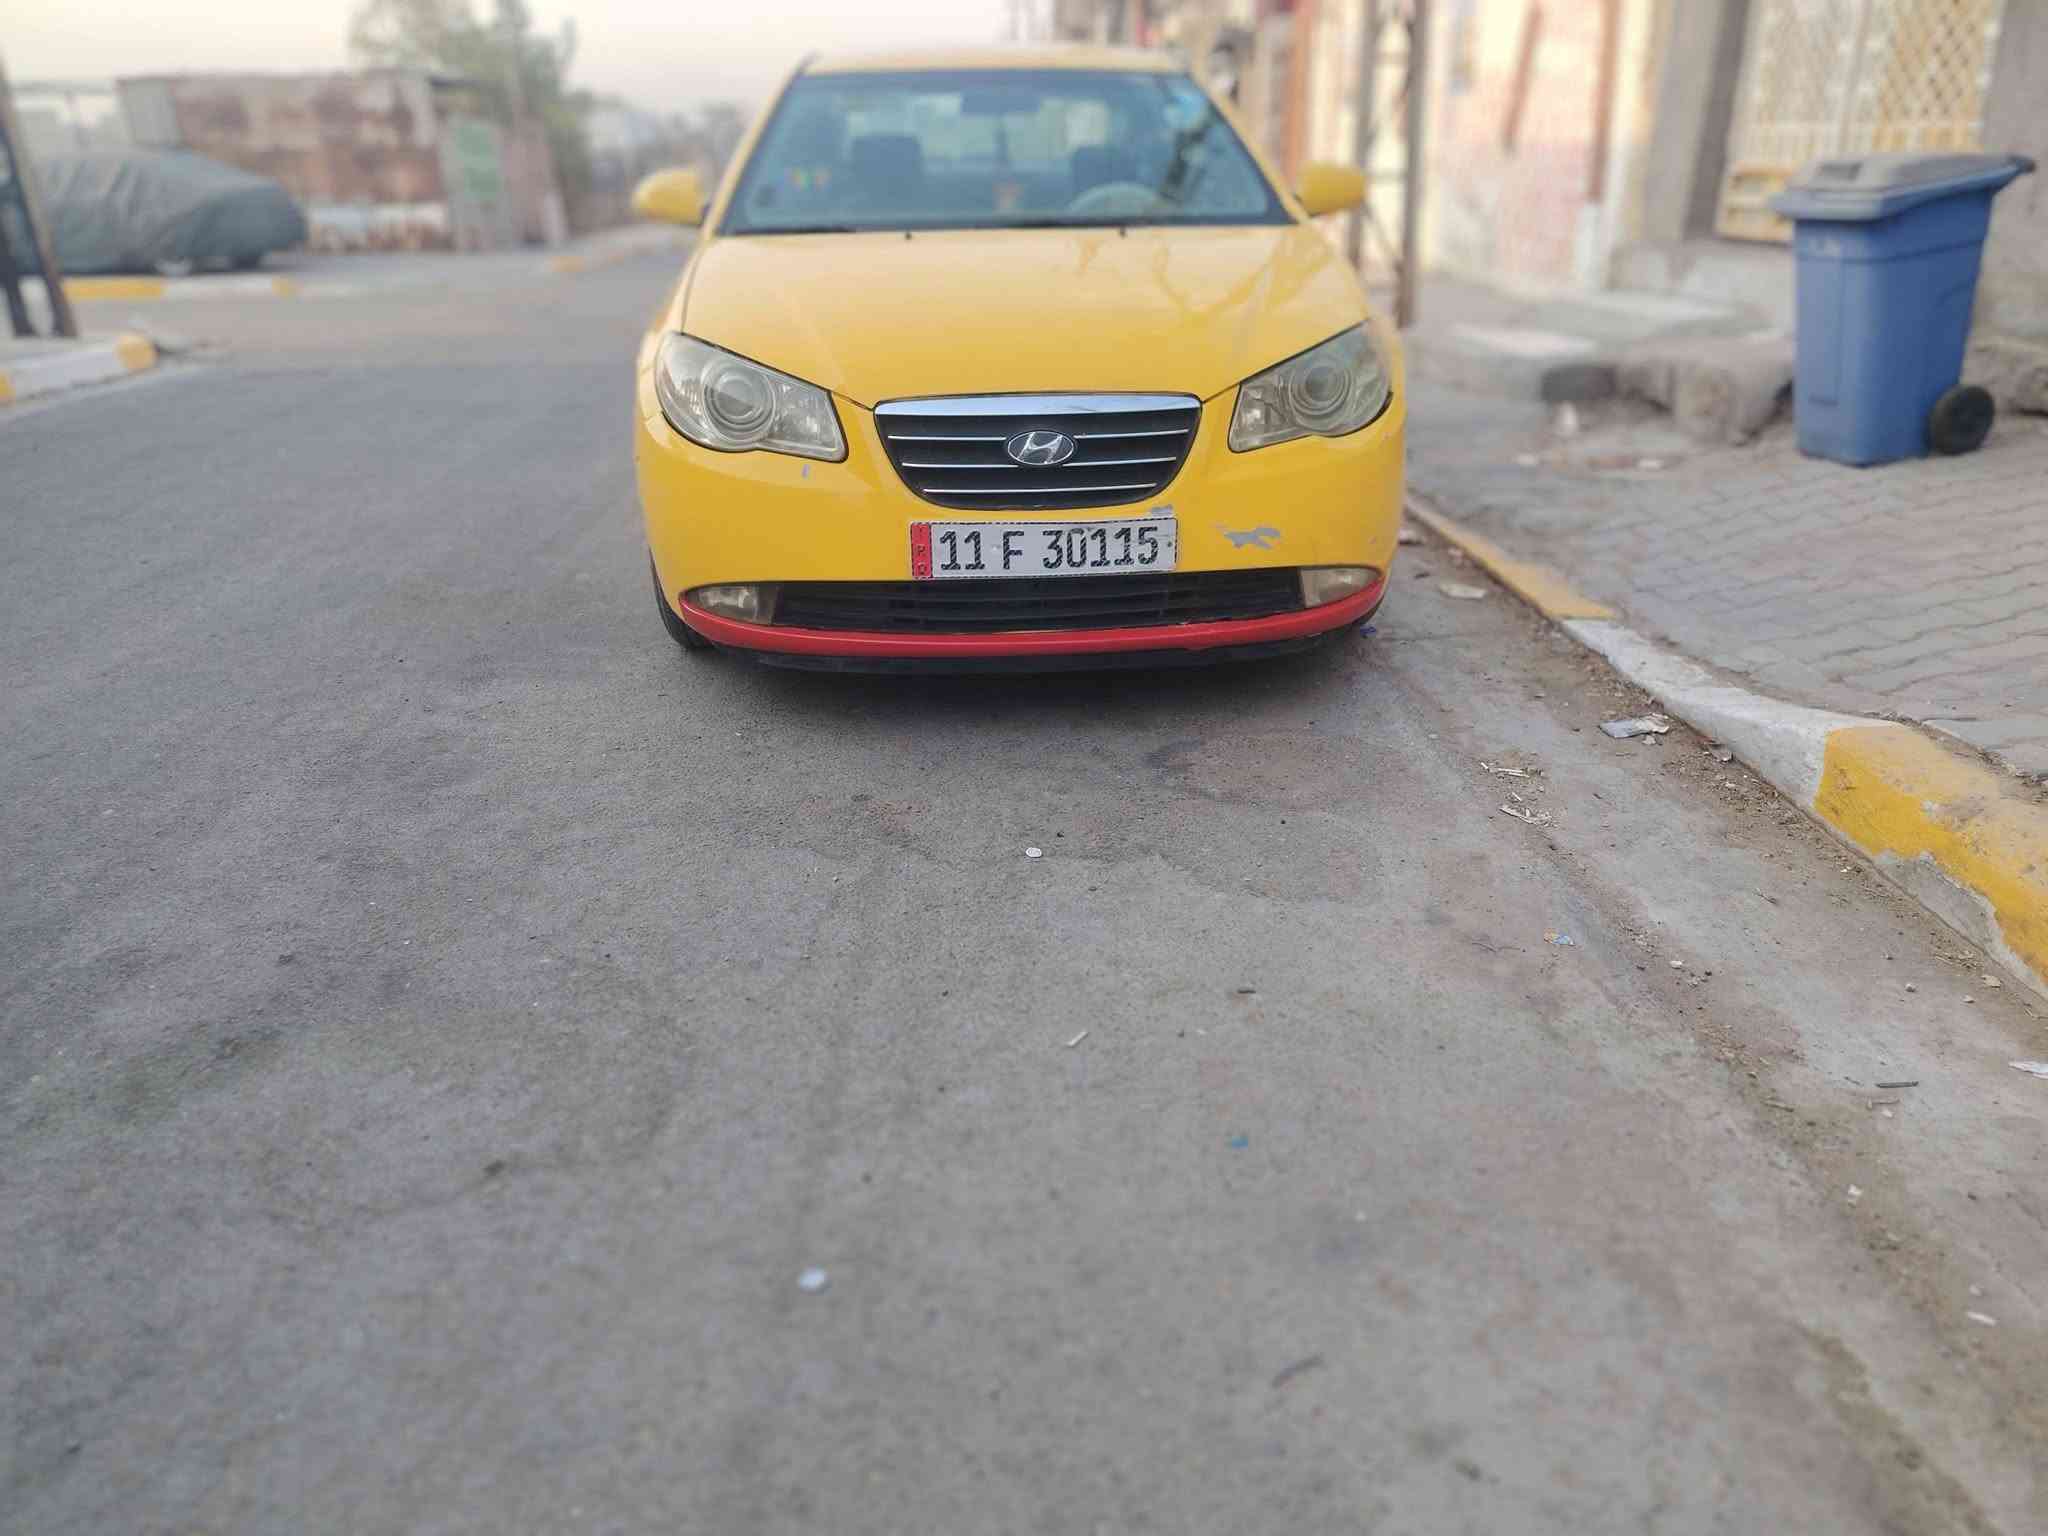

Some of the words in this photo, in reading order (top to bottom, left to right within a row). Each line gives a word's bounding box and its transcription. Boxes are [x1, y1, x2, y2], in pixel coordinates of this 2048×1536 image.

[940, 530, 985, 570] 11
[1003, 531, 1025, 569] F
[1042, 526, 1158, 569] 30115
